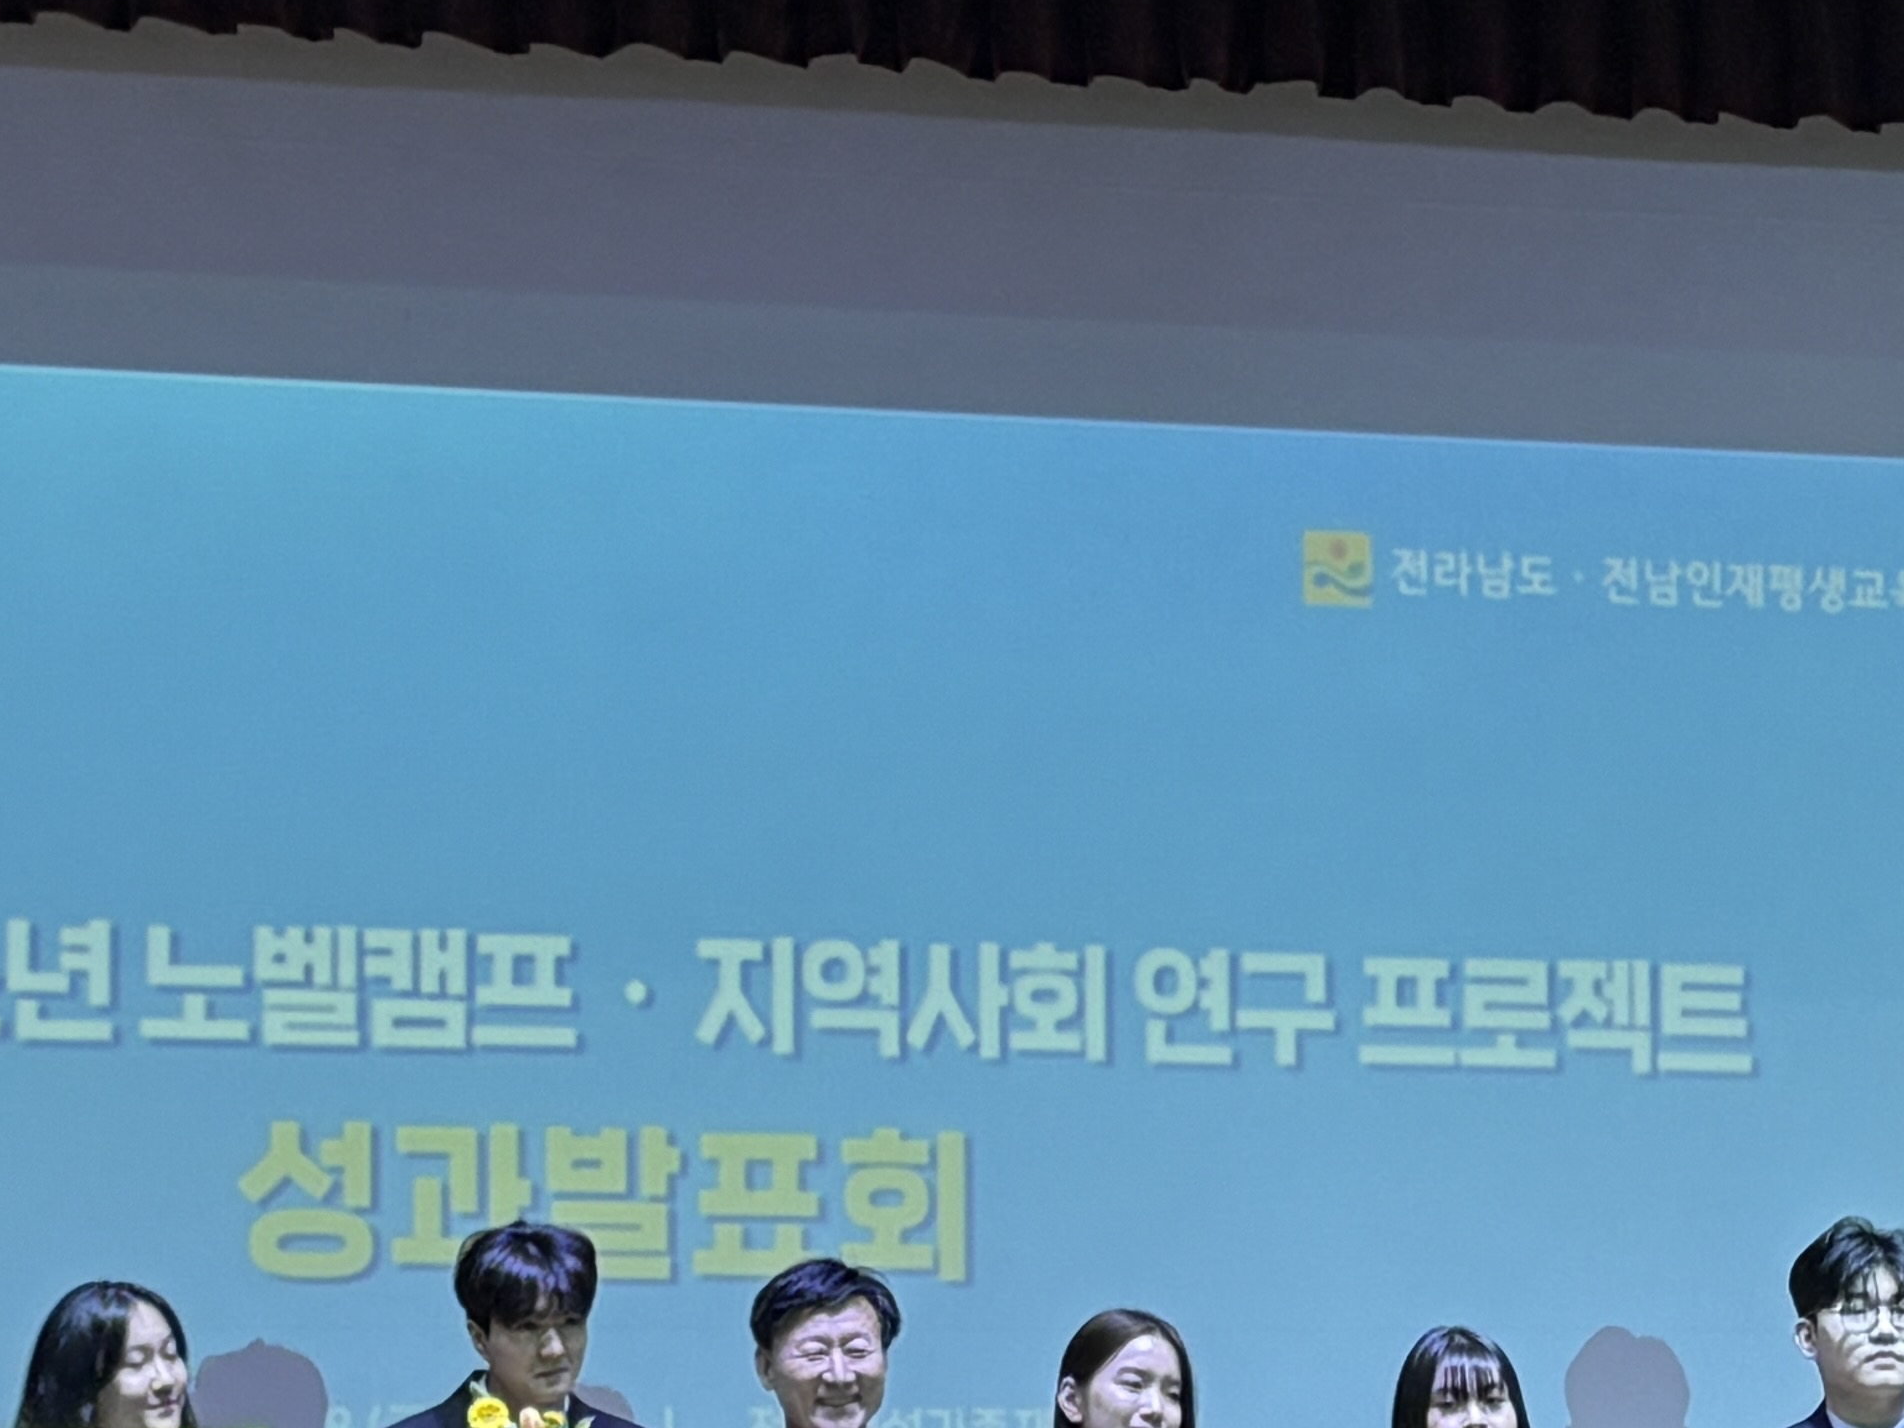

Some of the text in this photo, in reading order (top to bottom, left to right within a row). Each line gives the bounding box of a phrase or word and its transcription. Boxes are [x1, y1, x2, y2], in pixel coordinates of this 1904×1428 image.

[1392, 548, 1556, 599] 전라남도
[139, 926, 576, 1047] 노벨캠프
[696, 937, 1105, 1061] 지역사회
[1135, 948, 1334, 1065] 연구
[1359, 958, 1752, 1074] 프로젝트
[238, 1121, 968, 1285] 성과발표회
